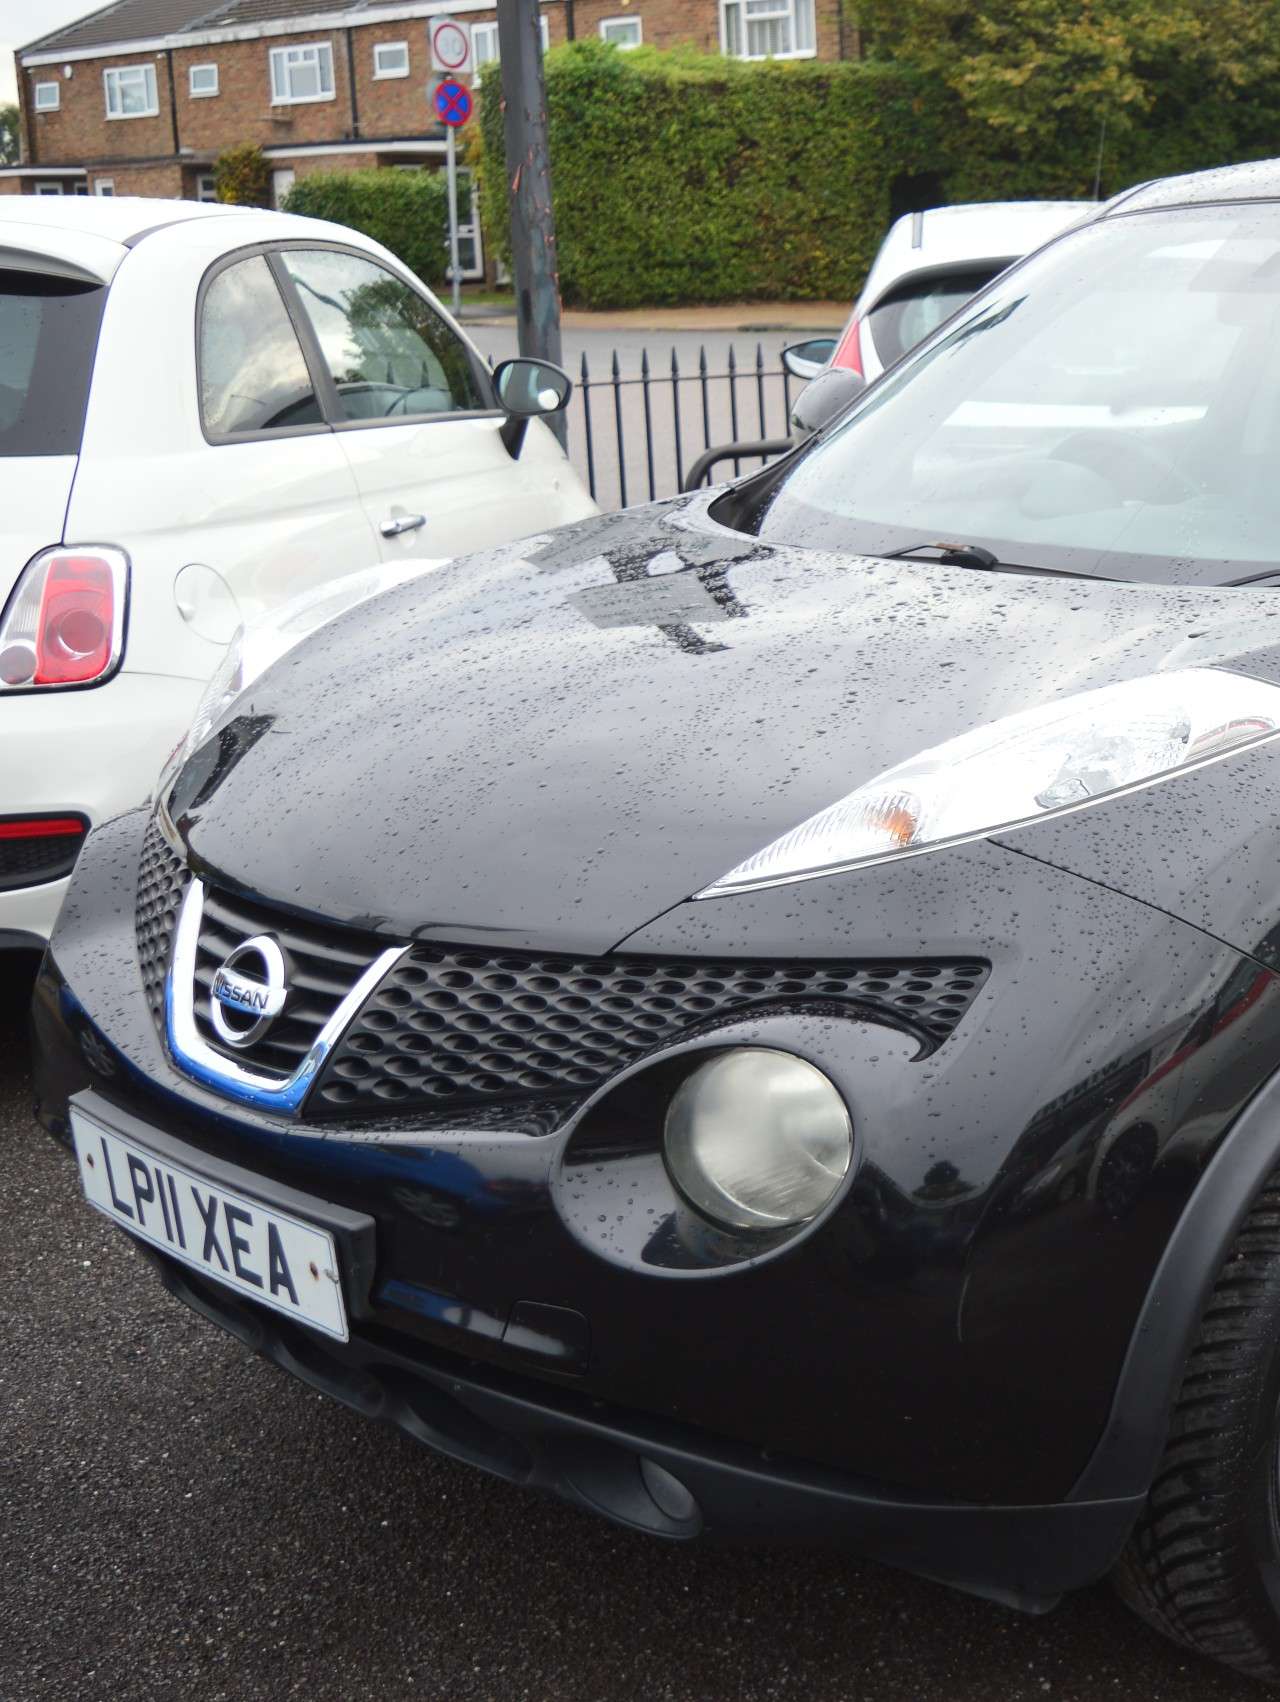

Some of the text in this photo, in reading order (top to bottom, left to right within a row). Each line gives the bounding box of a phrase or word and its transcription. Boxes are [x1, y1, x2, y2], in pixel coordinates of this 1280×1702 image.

[214, 973, 269, 1010] NISSAN
[101, 1136, 300, 1306] LP11 XEA
